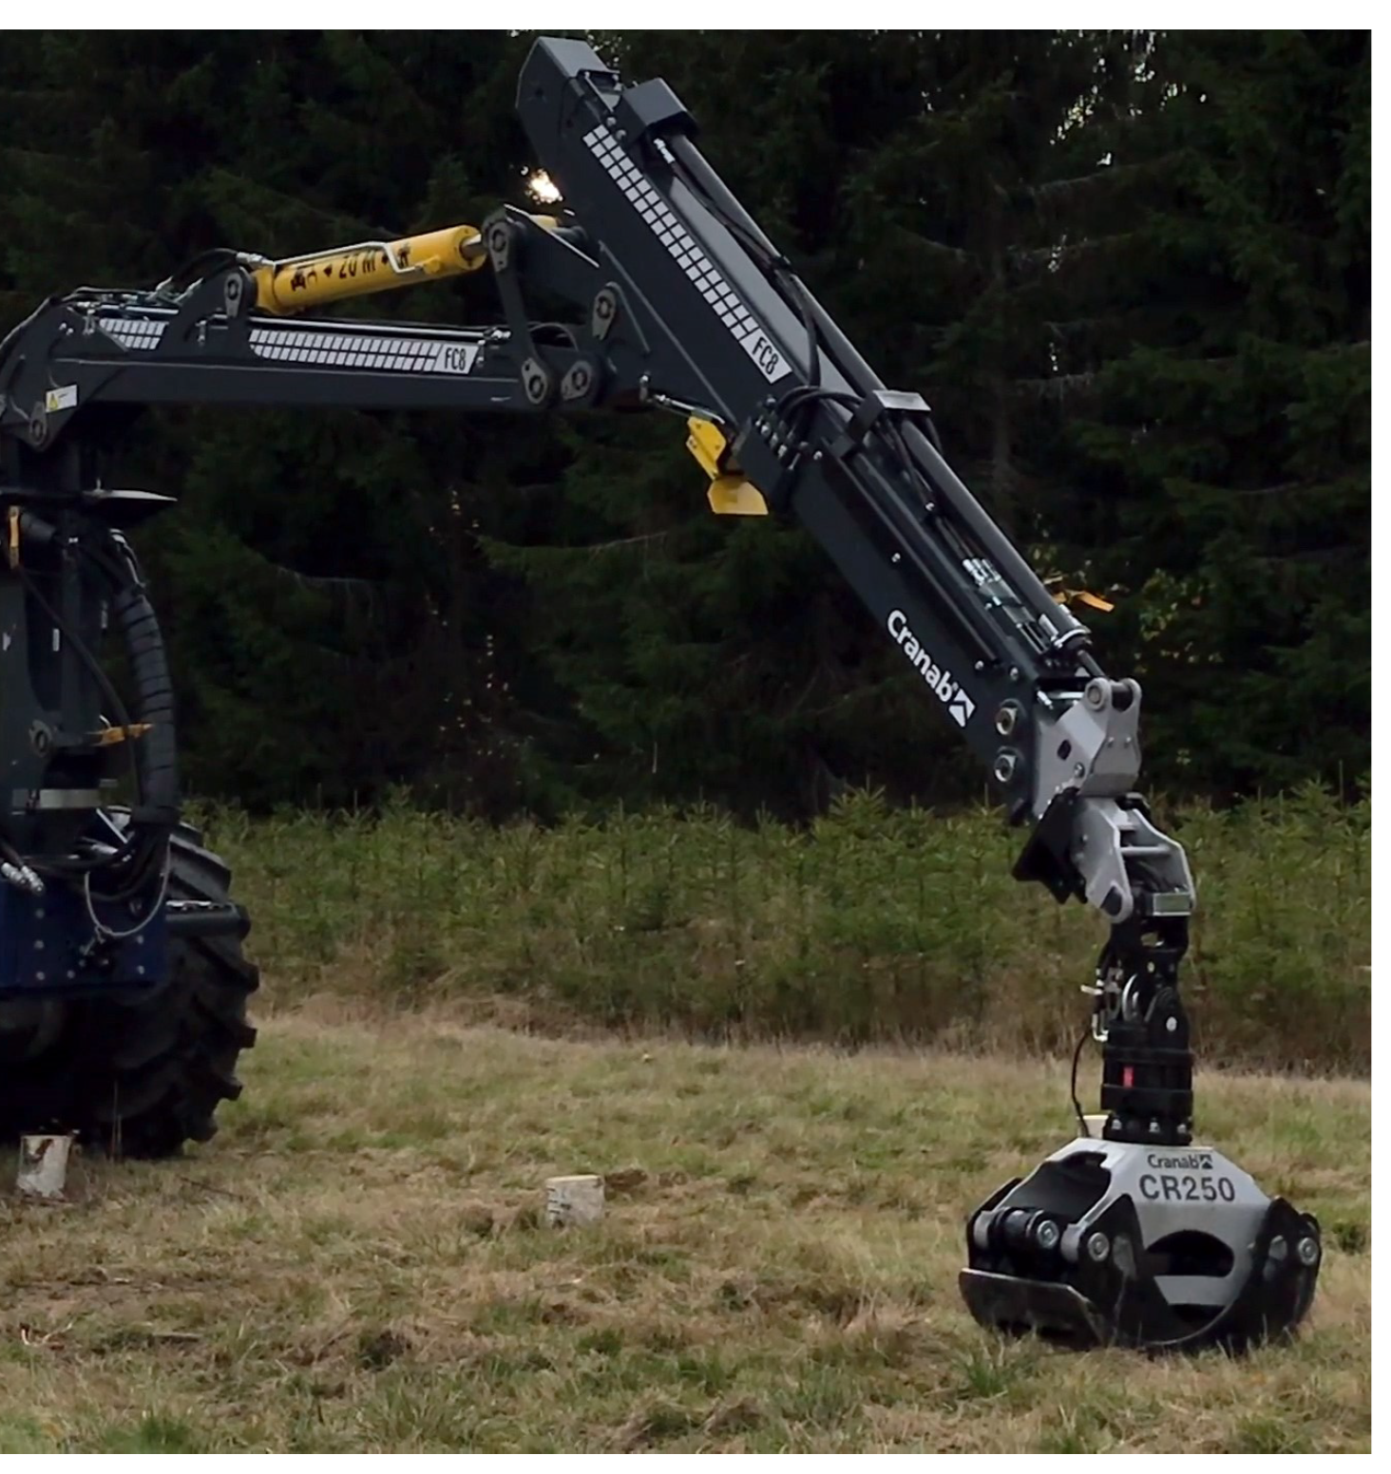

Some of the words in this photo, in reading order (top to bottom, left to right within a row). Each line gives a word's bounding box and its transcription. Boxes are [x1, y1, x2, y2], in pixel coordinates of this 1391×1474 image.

[444, 349, 466, 371] FC8
[751, 336, 779, 375] FC8
[887, 609, 954, 702] Cranab
[1147, 1153, 1200, 1170] Cranab
[1139, 1174, 1235, 1202] CR250
